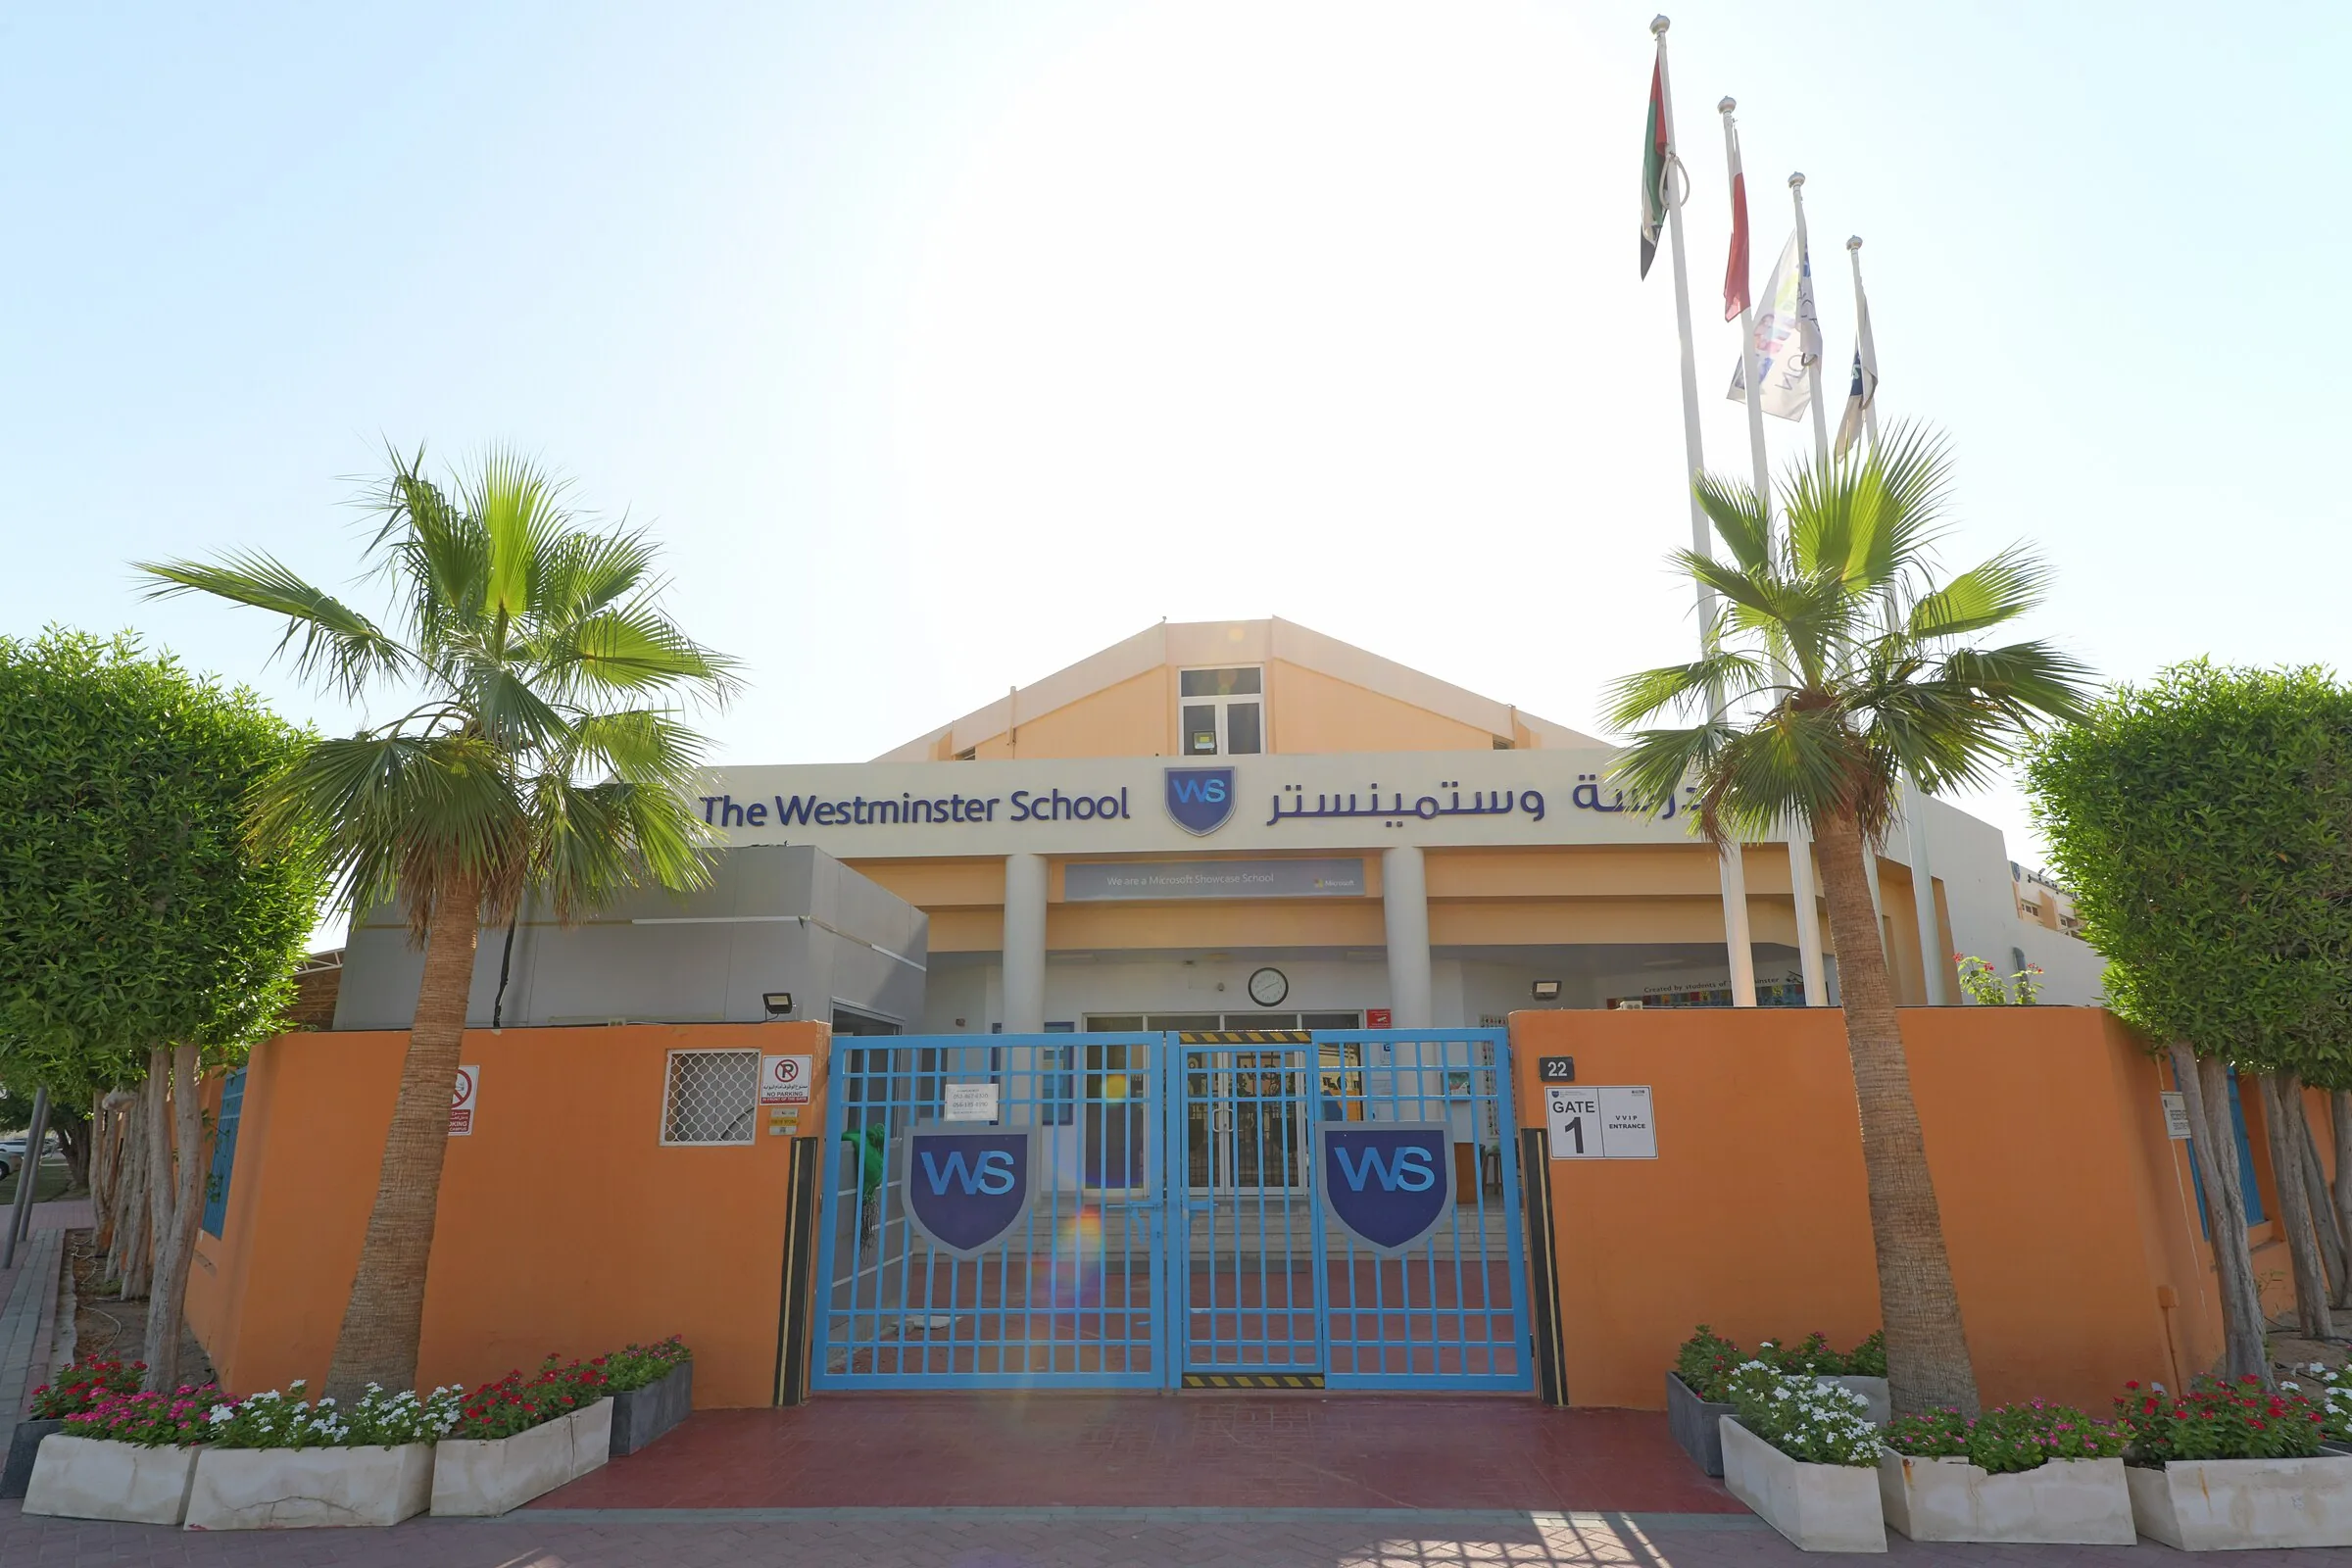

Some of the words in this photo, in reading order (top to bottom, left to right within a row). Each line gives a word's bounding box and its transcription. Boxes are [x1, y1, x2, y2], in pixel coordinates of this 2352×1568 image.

[699, 795, 767, 827] The
[775, 792, 1000, 827] Westminster
[1010, 786, 1130, 823] School
[1172, 778, 1226, 804] WS
[1266, 780, 1545, 828] وستمينستر
[1106, 877, 1121, 886] We
[1150, 874, 1194, 885] Microsoft
[1195, 874, 1241, 884] Showcase
[1242, 873, 1274, 883] School
[1643, 985, 1672, 994] Created
[1685, 982, 1716, 991] students
[1547, 1061, 1568, 1077] 22
[1552, 1101, 1595, 1113] GATE
[1564, 1116, 1585, 1153] 1
[920, 1150, 1015, 1196] WS
[1334, 1146, 1435, 1193] WS
